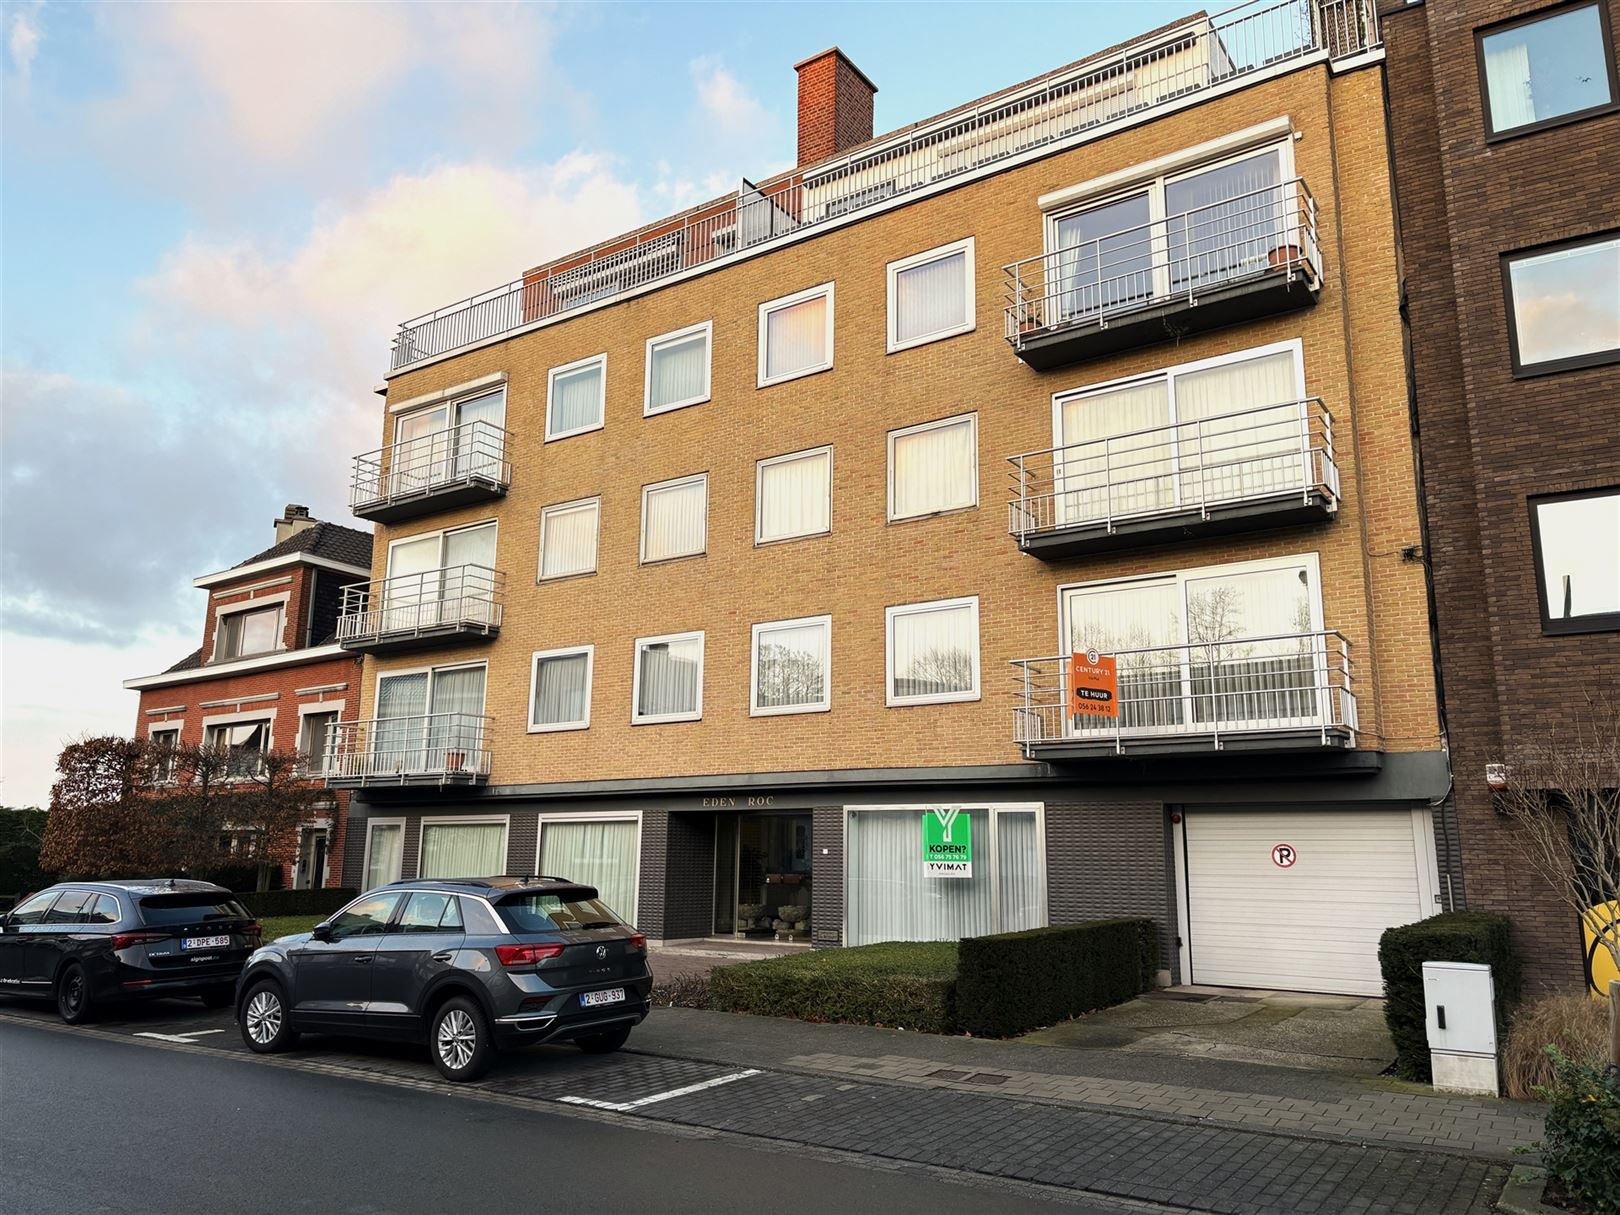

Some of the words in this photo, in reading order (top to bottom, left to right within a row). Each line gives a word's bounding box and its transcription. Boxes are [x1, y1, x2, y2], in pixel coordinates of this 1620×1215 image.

[1075, 666, 1103, 675] CENTURY
[1090, 691, 1108, 699] HUUR
[703, 797, 736, 807] EDEN
[748, 796, 774, 806] ROC
[929, 845, 967, 853] KOPEN?
[929, 863, 967, 871] YVIMAT
